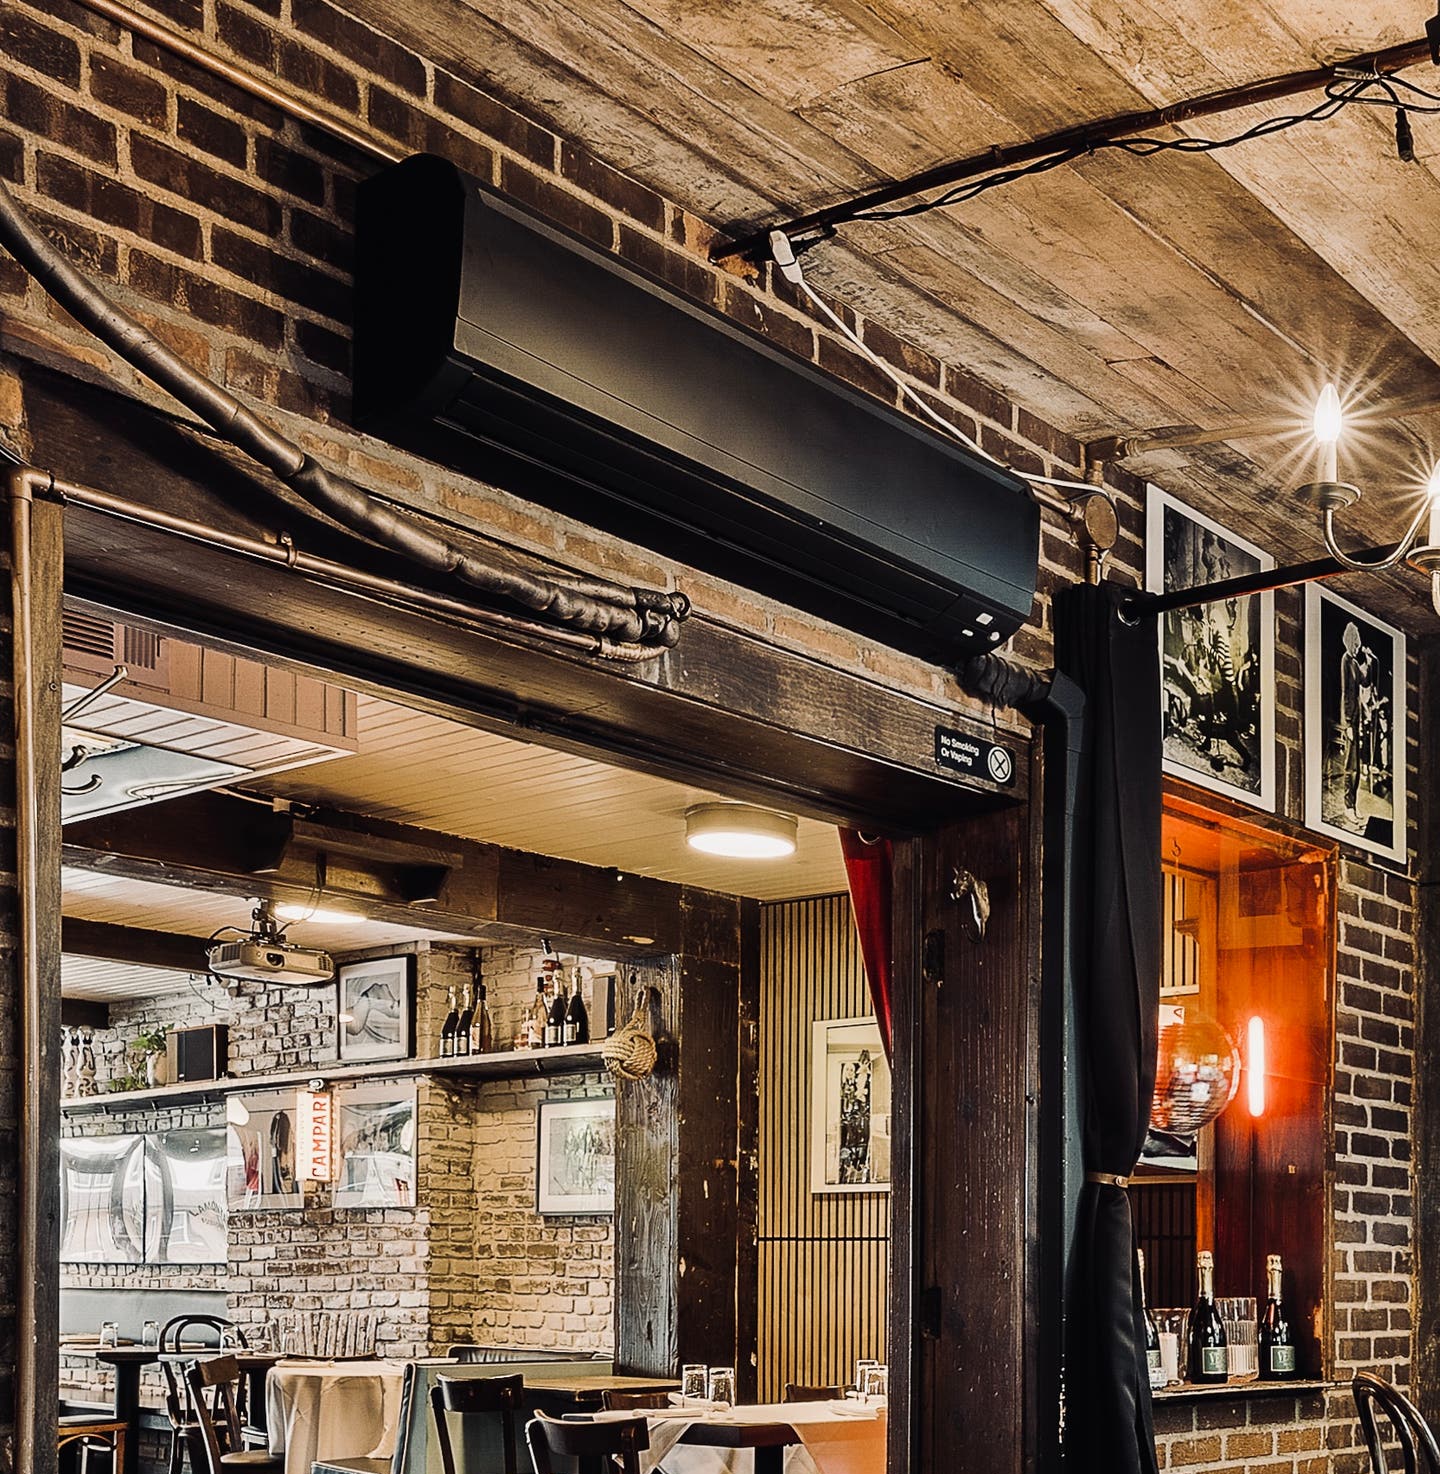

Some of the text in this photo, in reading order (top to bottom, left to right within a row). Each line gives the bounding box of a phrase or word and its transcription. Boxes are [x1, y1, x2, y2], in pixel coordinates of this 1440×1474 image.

[941, 735, 979, 756] No Smoking
[941, 747, 973, 766] Or Vaping
[312, 1092, 327, 1177] CAMPARI
